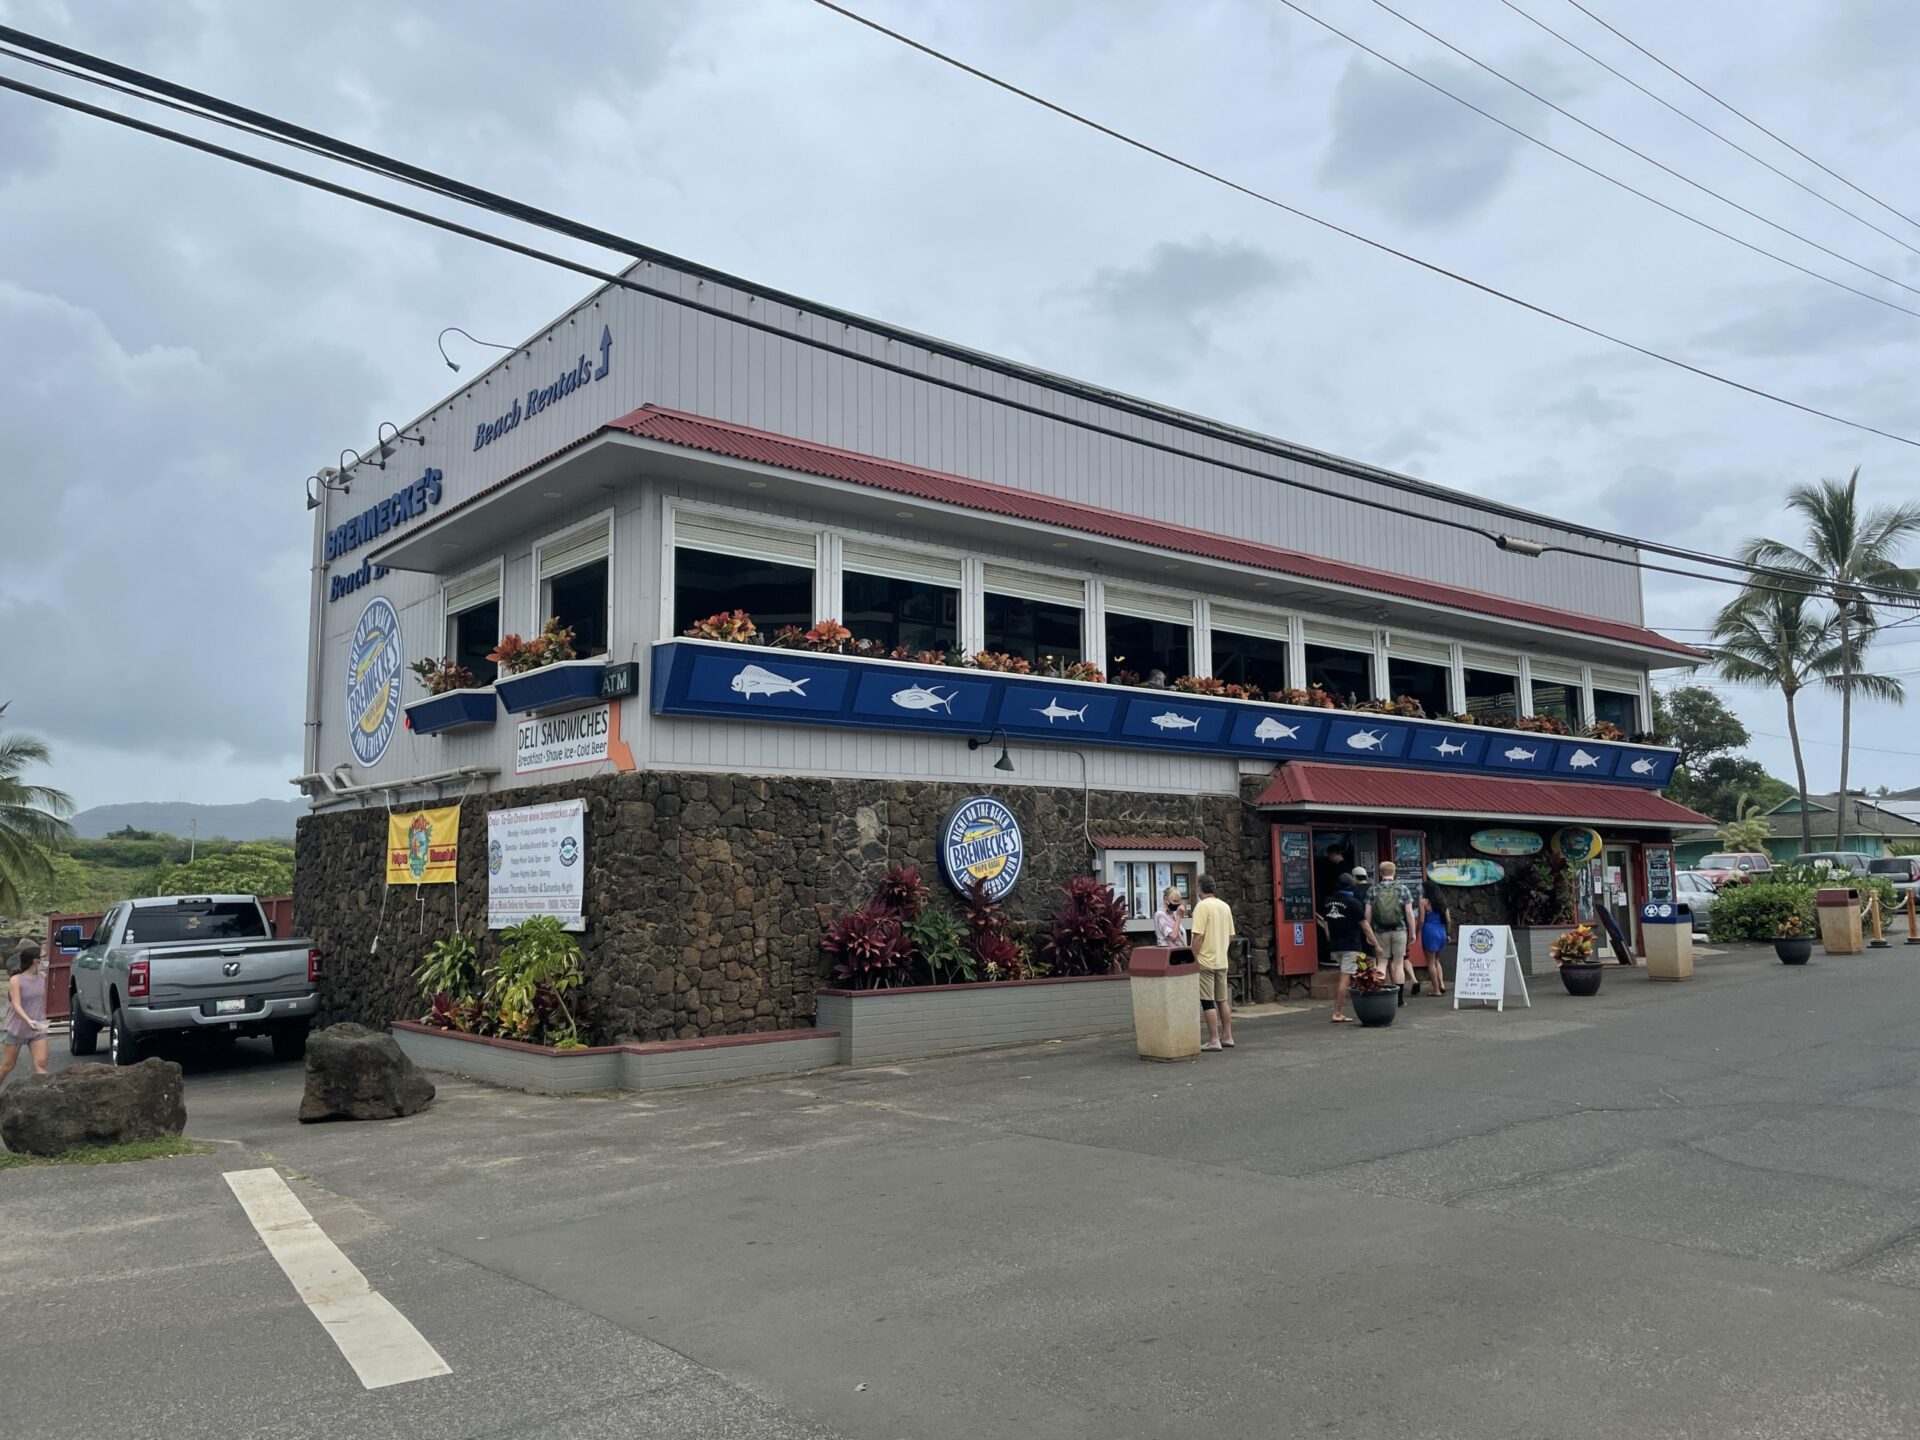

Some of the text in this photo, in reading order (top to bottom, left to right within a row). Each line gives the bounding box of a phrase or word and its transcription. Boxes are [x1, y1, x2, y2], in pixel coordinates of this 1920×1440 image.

[473, 353, 593, 452] Beach Rentals
[325, 467, 443, 562] BRENNECKE'S
[329, 558, 372, 602] Beach
[348, 640, 361, 686] RIGHT
[357, 622, 366, 646] ON
[349, 631, 399, 728] BRENNECKE'S
[388, 677, 400, 708] FUN
[602, 671, 627, 694] ATM
[518, 710, 608, 751] DELI SANDWICHES
[564, 746, 574, 759] Ice
[576, 742, 590, 756] Cold
[591, 740, 607, 755] Beer
[951, 803, 1011, 842] RIGHT ON THE BEACH
[953, 830, 1016, 868] BRENNECKE'S
[1005, 855, 1019, 875] FUN
[1001, 872, 1011, 882] &
